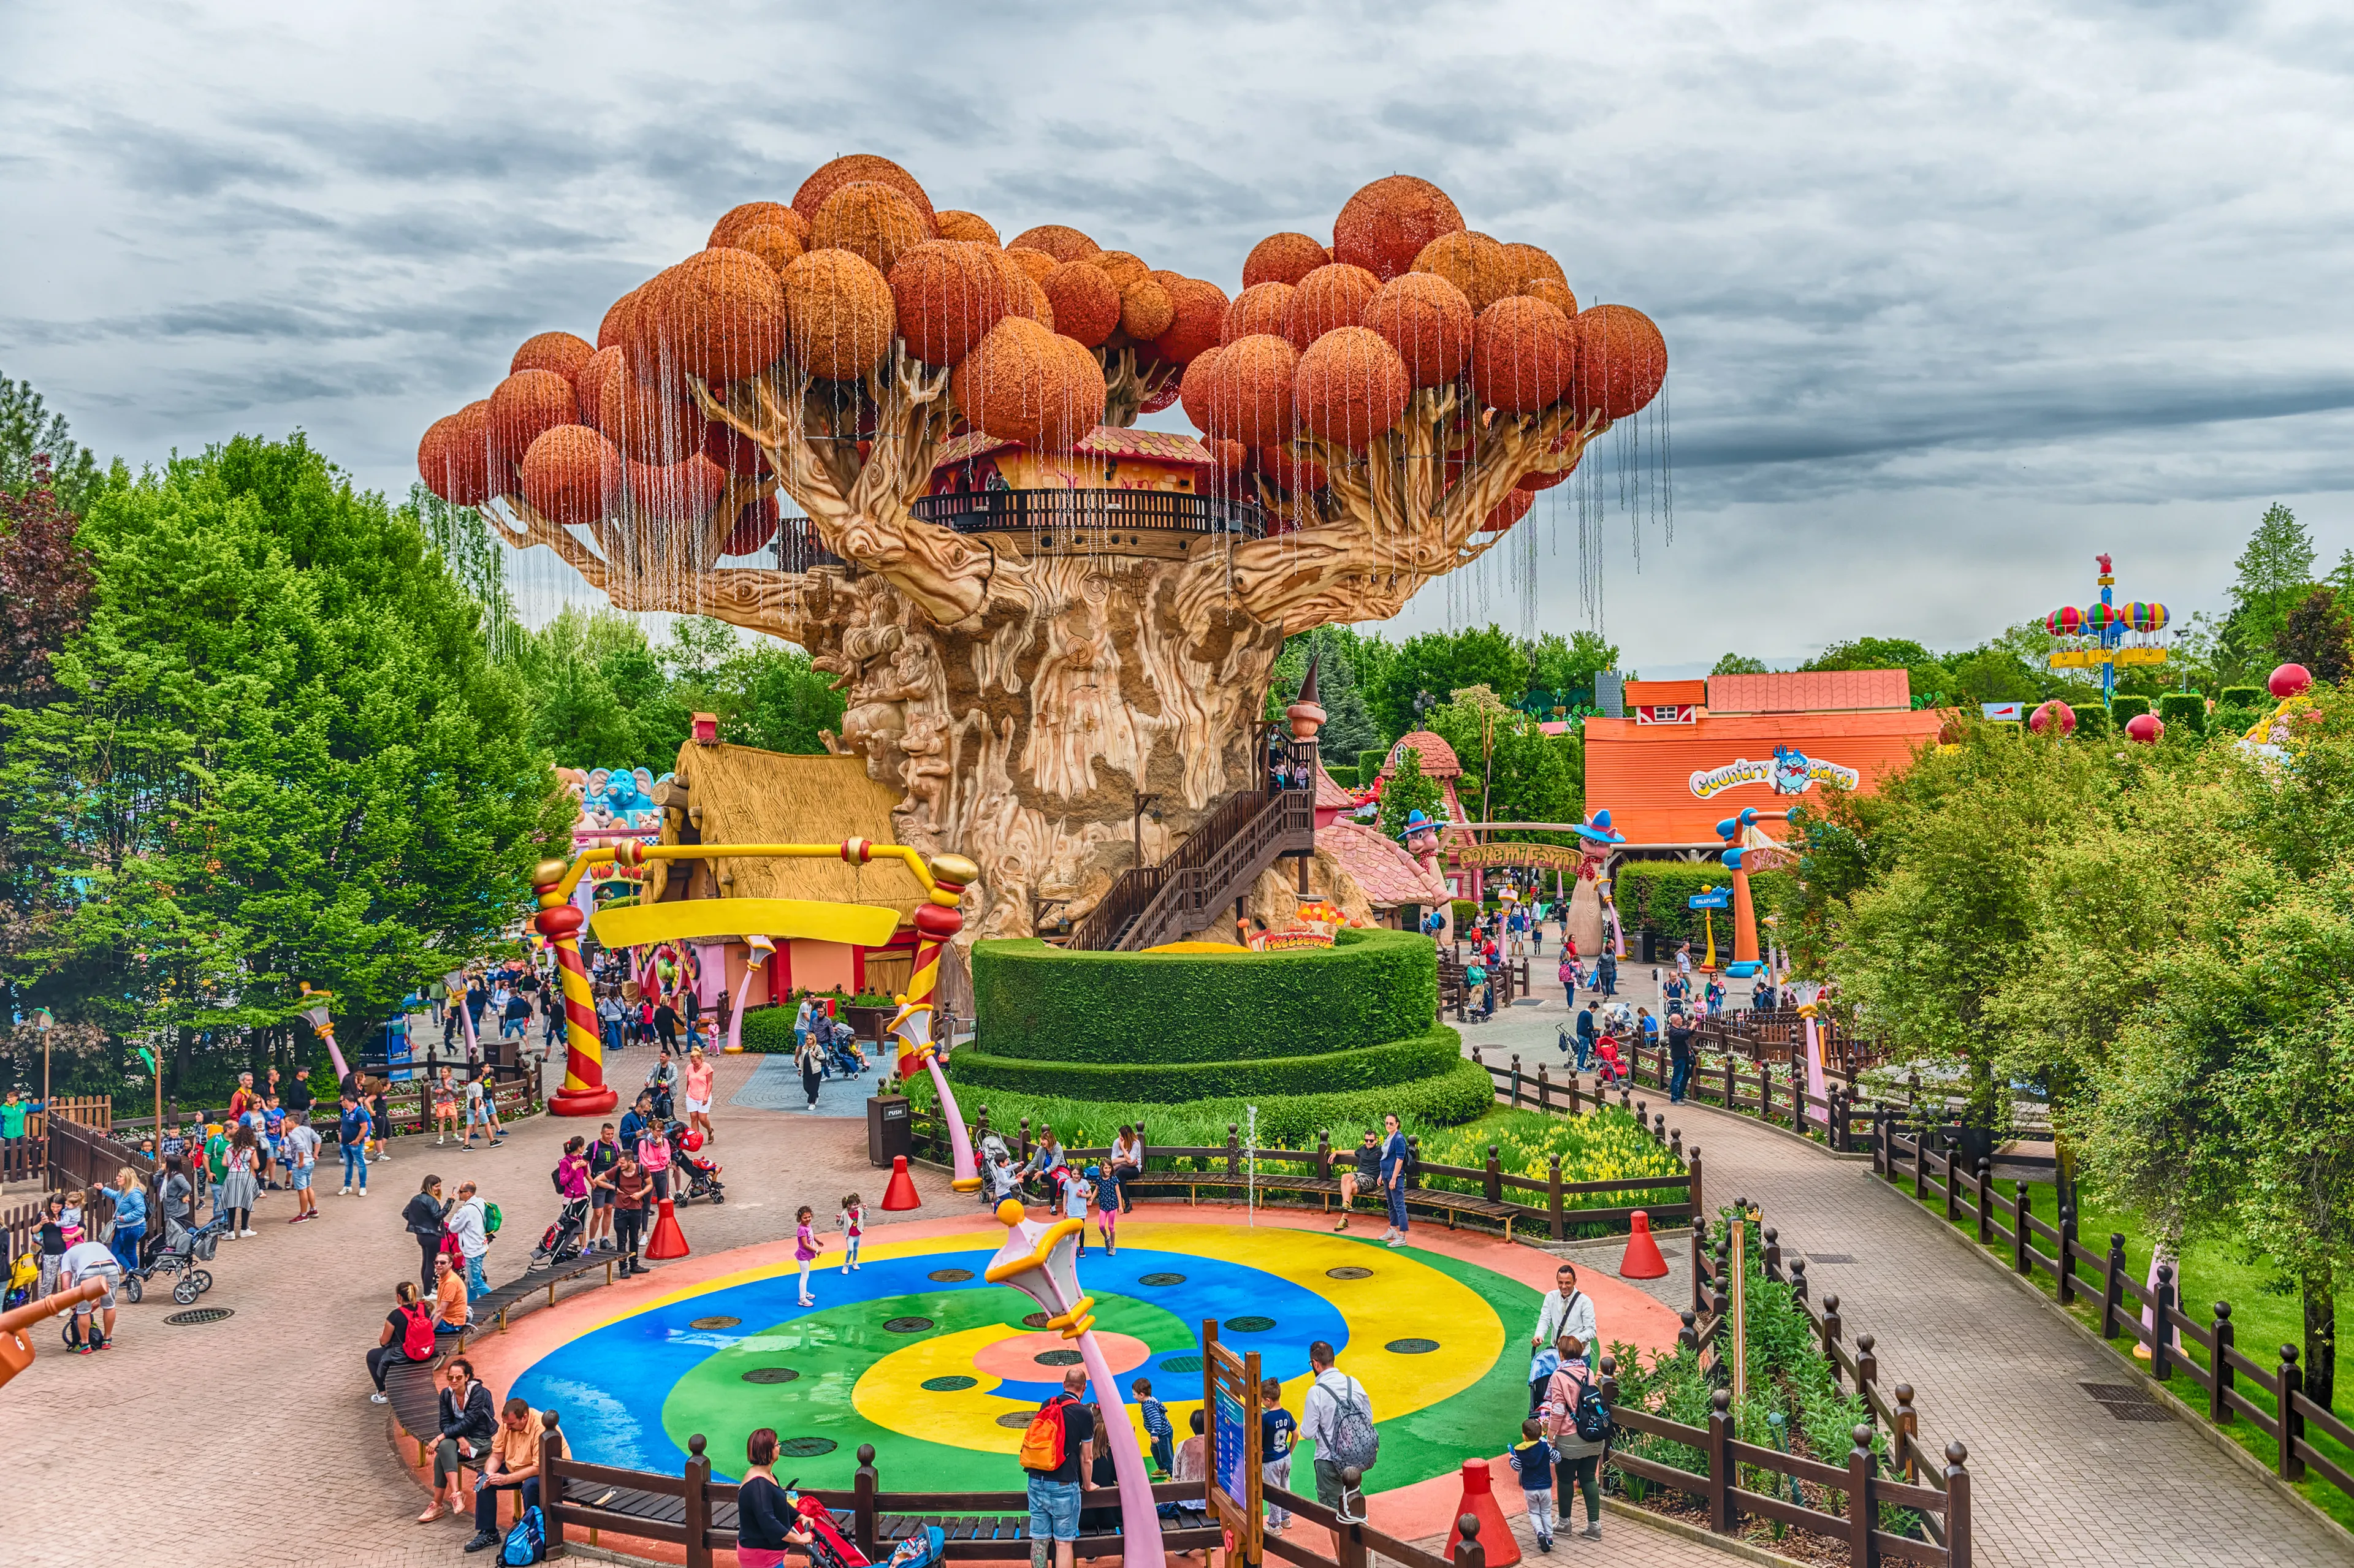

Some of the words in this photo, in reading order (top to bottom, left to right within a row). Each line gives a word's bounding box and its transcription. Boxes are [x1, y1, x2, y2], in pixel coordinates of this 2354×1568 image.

[1691, 761, 1769, 796] Country
[1808, 760, 1854, 786] Barn
[590, 860, 614, 879] OYS
[1264, 933, 1335, 951] PREZZEMOL
[15, 1336, 25, 1351] 6
[1276, 1419, 1288, 1429] EDO
